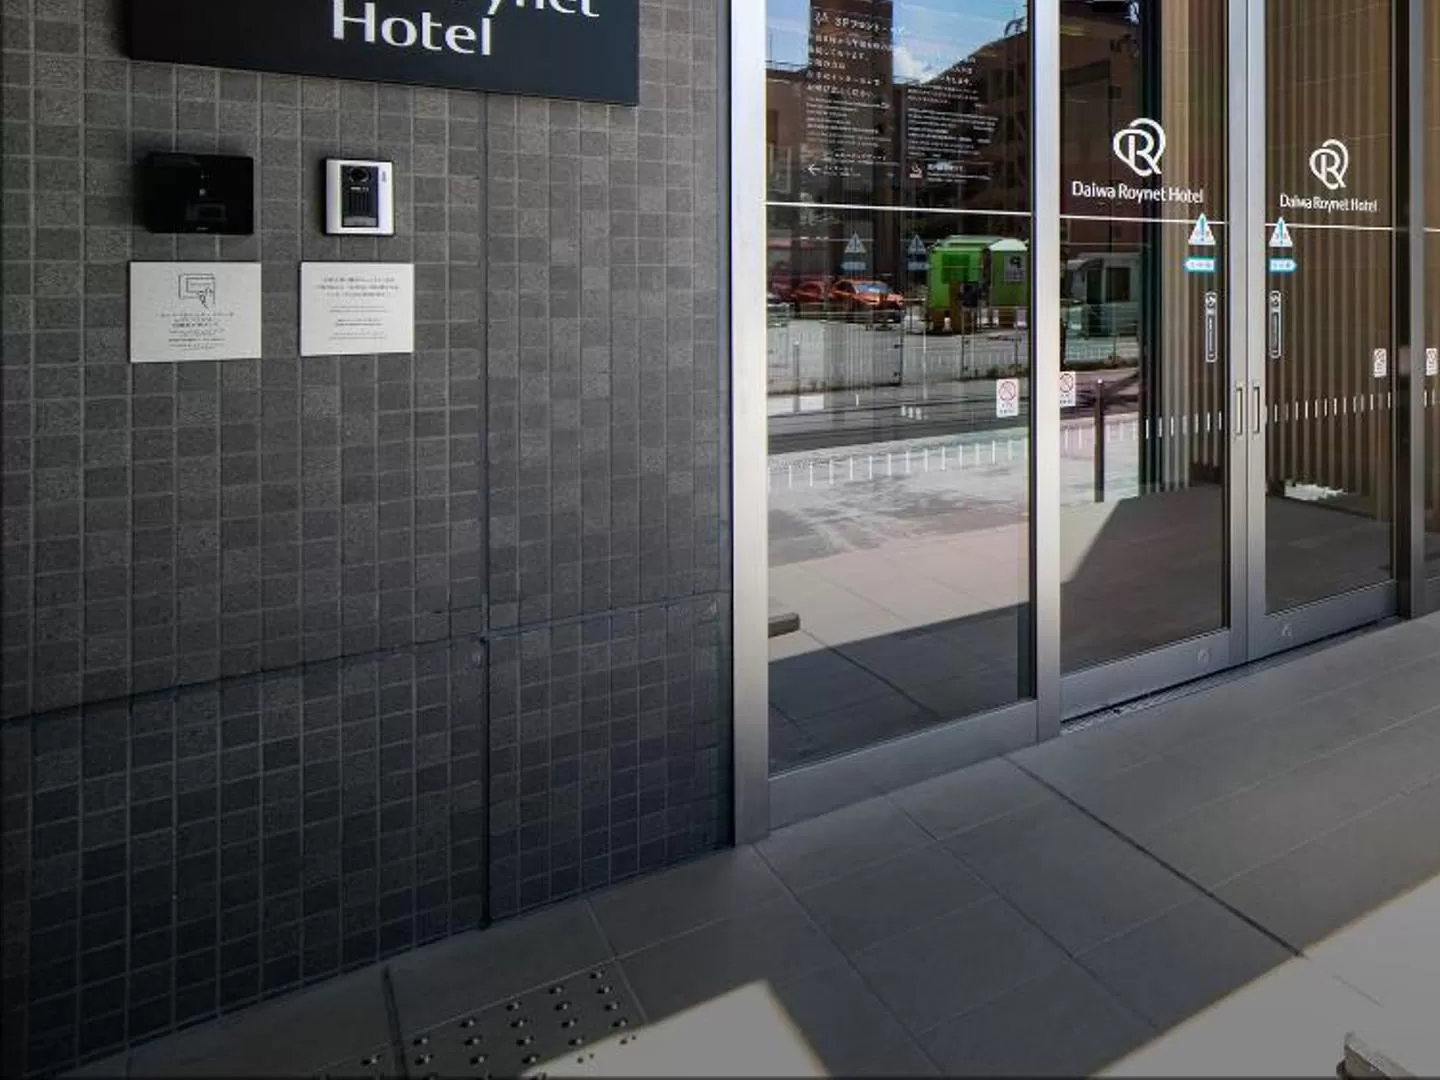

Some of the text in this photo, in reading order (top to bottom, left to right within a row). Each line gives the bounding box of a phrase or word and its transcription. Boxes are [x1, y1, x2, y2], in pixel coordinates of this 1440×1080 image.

[1071, 180, 1204, 204] Daiwa Roynet Hotel
[1279, 193, 1378, 213] Daiwa Roynet Hotel
